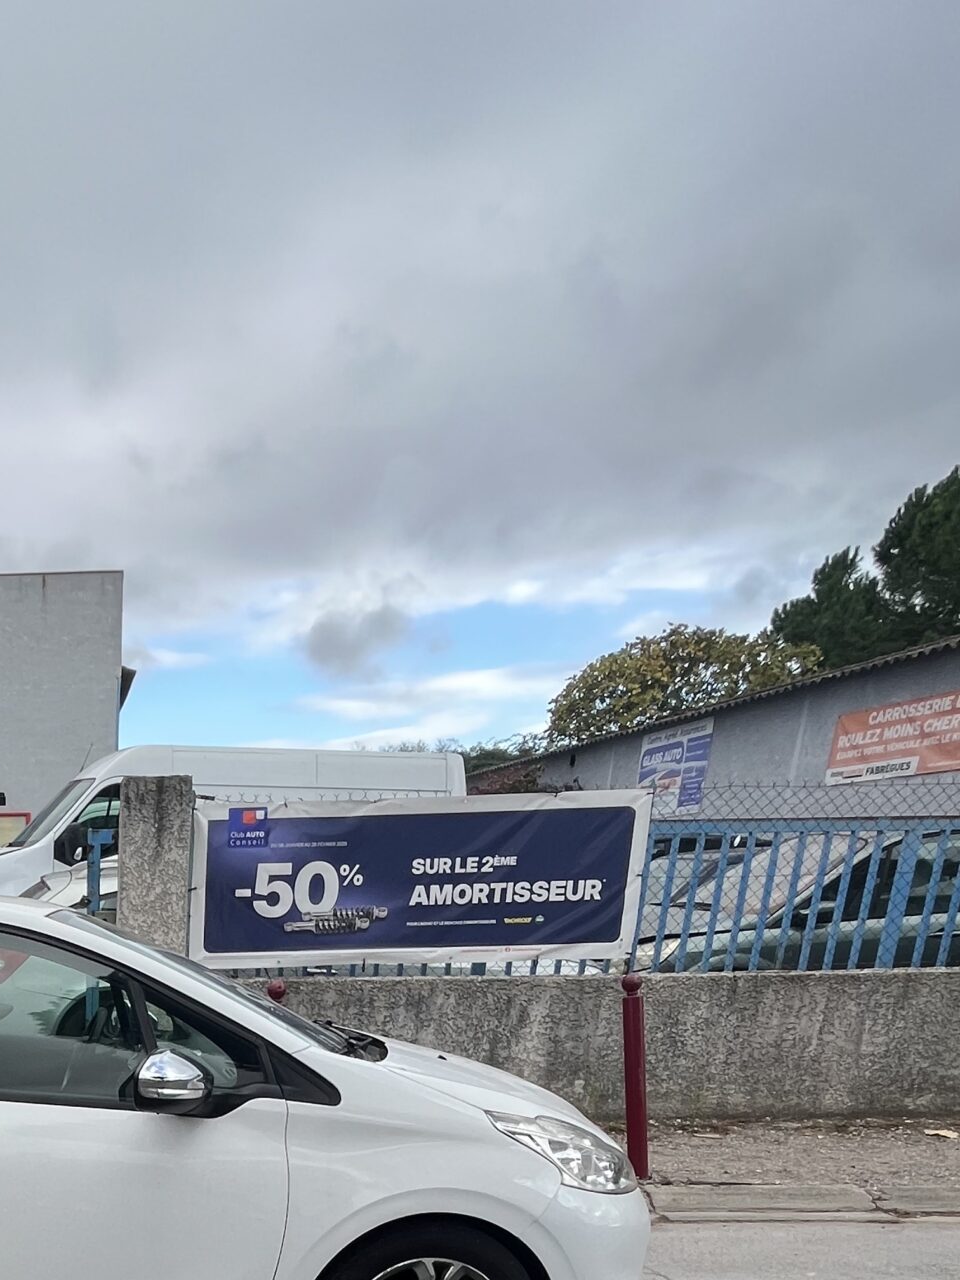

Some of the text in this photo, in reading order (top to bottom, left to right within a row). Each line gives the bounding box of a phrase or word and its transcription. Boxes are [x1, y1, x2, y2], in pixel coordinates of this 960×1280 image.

[868, 695, 956, 725] CARROSSERIE
[837, 728, 881, 749] ROULEZ
[882, 720, 921, 741] MOINS
[642, 751, 664, 768] GLASS
[229, 838, 265, 847] Conseil
[230, 830, 265, 839] Club AUTO
[411, 857, 453, 875] SUR
[454, 856, 479, 874] LE
